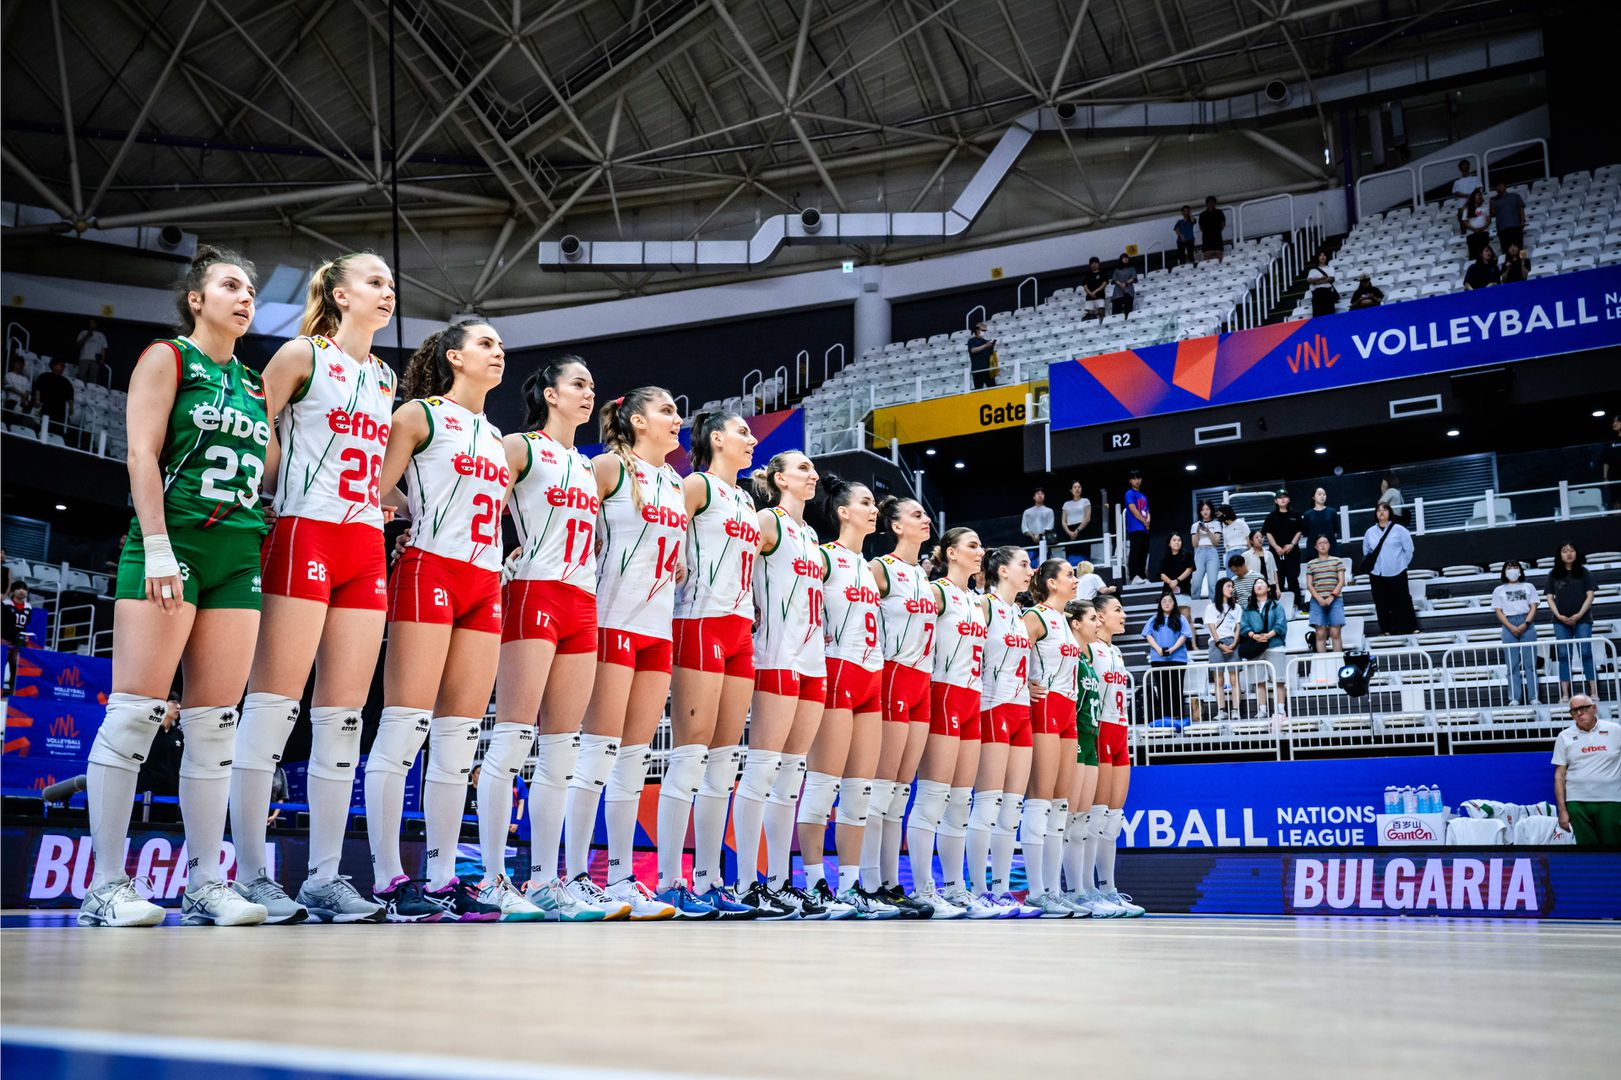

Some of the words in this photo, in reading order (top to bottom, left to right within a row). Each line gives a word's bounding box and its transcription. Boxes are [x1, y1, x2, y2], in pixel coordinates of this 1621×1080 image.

[1605, 292, 1621, 305] N
[1286, 334, 1341, 374] VNL
[1351, 298, 1598, 359] VOLLEYBALL
[980, 402, 1026, 426] Gate
[1112, 433, 1131, 448] R2
[200, 445, 265, 509] 23
[338, 447, 383, 509] 28
[470, 493, 501, 548] 21
[563, 518, 593, 566] 17
[655, 536, 681, 581] 14
[179, 562, 190, 581] 3
[307, 561, 327, 582] 28
[741, 550, 753, 592] 11
[433, 588, 448, 606] 21
[807, 587, 823, 627] 10
[16, 613, 27, 625] 10
[536, 610, 550, 627] 17
[864, 612, 878, 648] 9
[923, 623, 934, 656] 7
[617, 635, 630, 652] 14
[713, 644, 722, 659] 11
[971, 645, 983, 678] 5
[1015, 655, 1027, 685] 4
[57, 666, 84, 687] VNL
[54, 687, 85, 695] VOLLEYBALL
[897, 700, 904, 712] 7
[49, 714, 80, 738] VNL
[951, 716, 958, 729] 5
[1001, 721, 1007, 733] 4
[47, 738, 81, 746] VOLLEYBALL
[1581, 745, 1608, 753] efbet
[1277, 805, 1376, 825] NATIONS
[1393, 820, 1422, 829] 百岁山
[1119, 808, 1268, 847] YBALL
[1278, 828, 1365, 847] LEAGUE
[1293, 857, 1538, 911] BULGARIA
